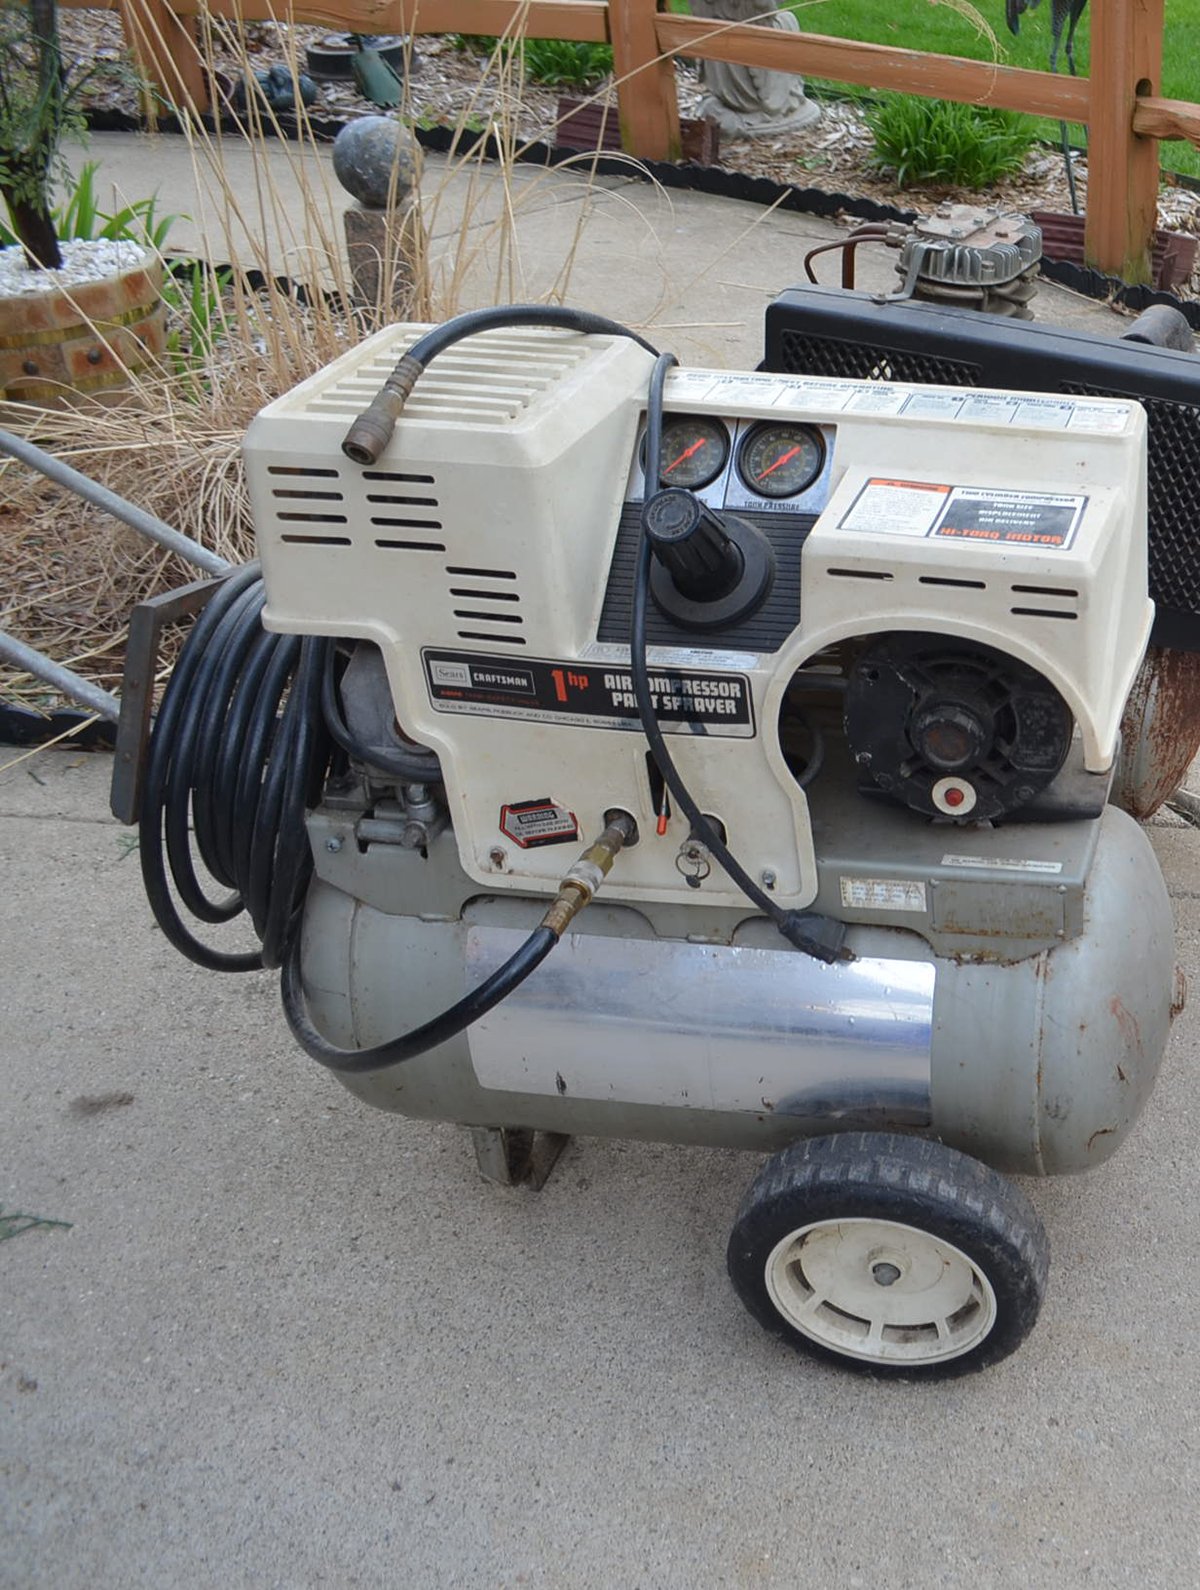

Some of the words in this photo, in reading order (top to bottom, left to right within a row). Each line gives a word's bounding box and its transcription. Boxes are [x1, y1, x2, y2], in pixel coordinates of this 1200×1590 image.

[1005, 532, 1065, 545] MOTOR
[473, 672, 528, 687] CRAFTSMAN
[603, 674, 633, 691] AIR
[647, 676, 742, 699] MPRESSOR
[612, 692, 659, 710] PAIT
[662, 695, 737, 715] SPRAYER
